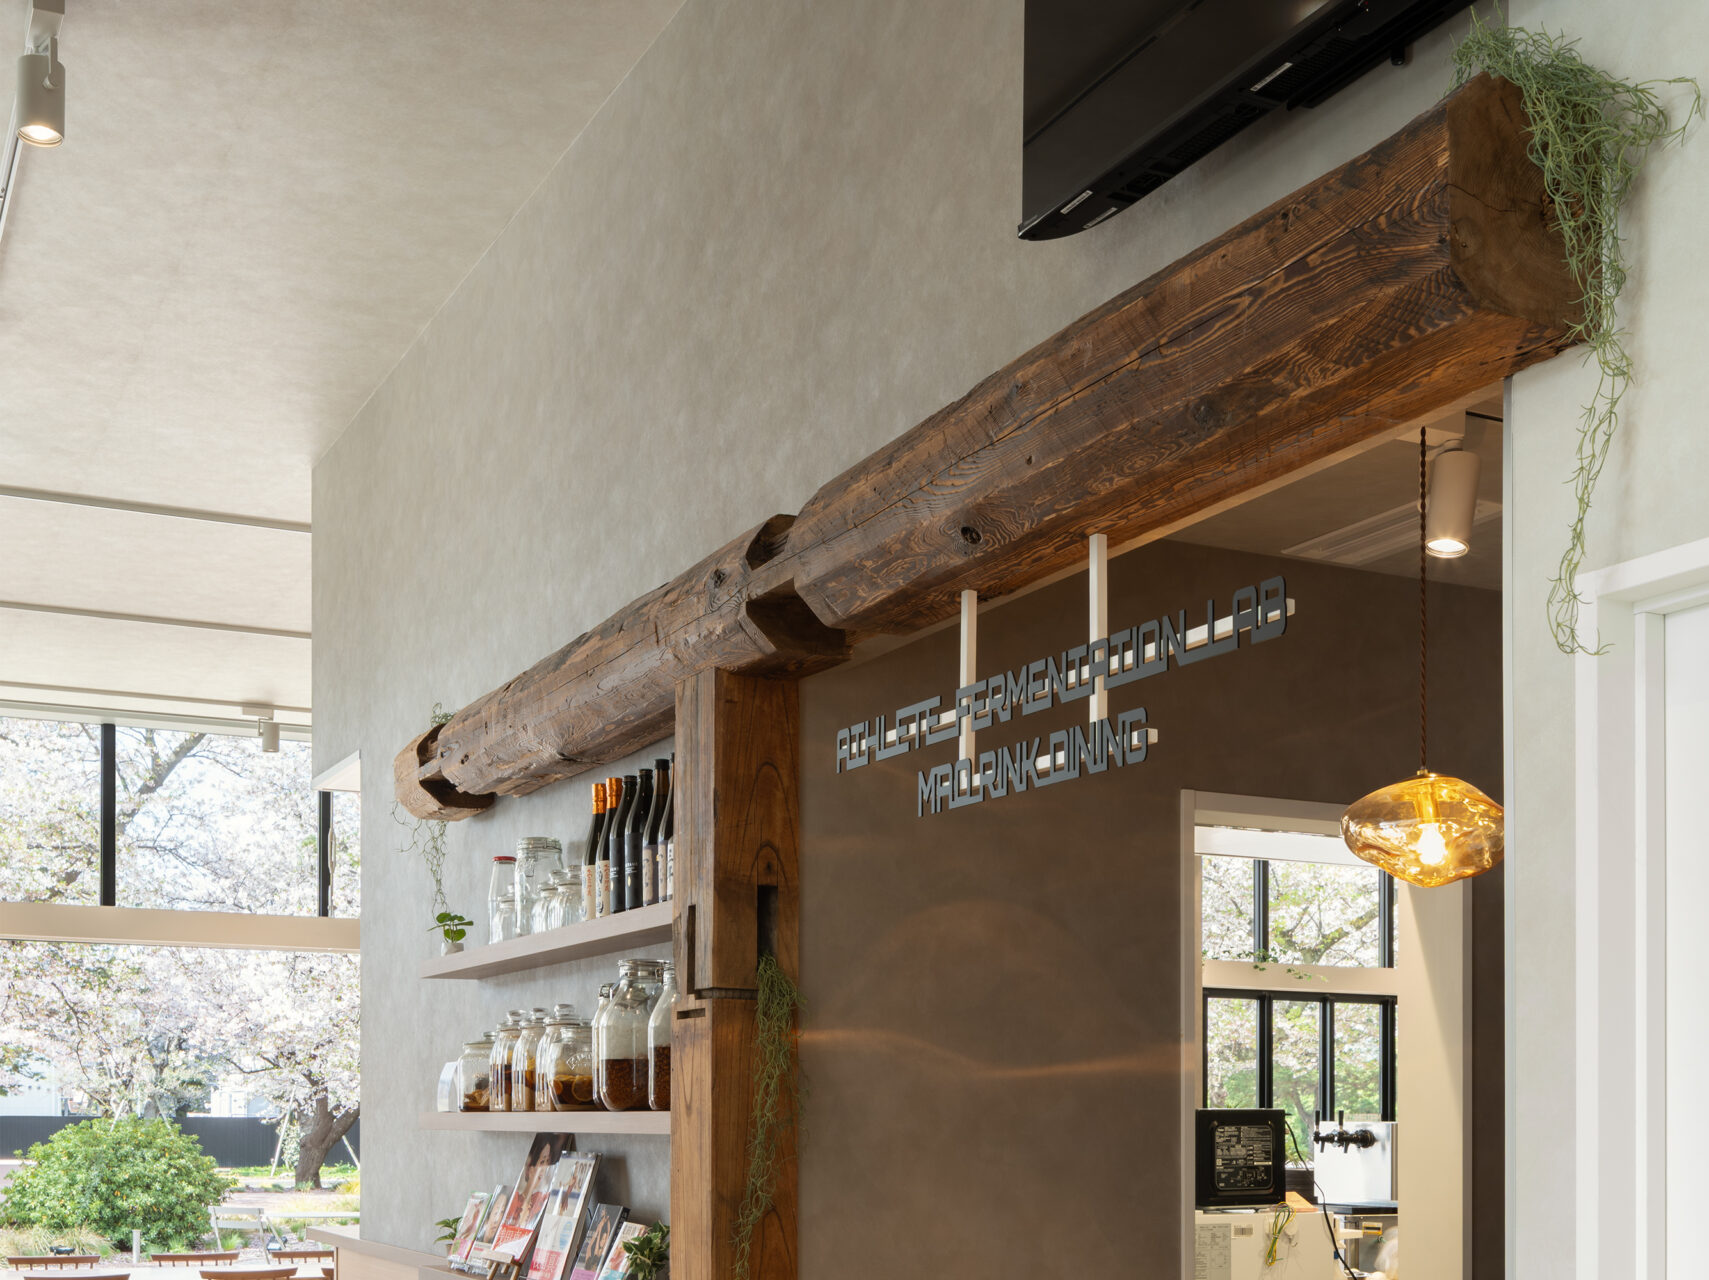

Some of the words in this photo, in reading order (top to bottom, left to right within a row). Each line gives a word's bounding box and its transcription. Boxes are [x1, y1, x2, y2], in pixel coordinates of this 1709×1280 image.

[836, 695, 943, 774] ATHLETE
[956, 608, 1186, 734] FERMENTATION
[1205, 575, 1286, 656] LAB
[1048, 706, 1149, 784] DINING
